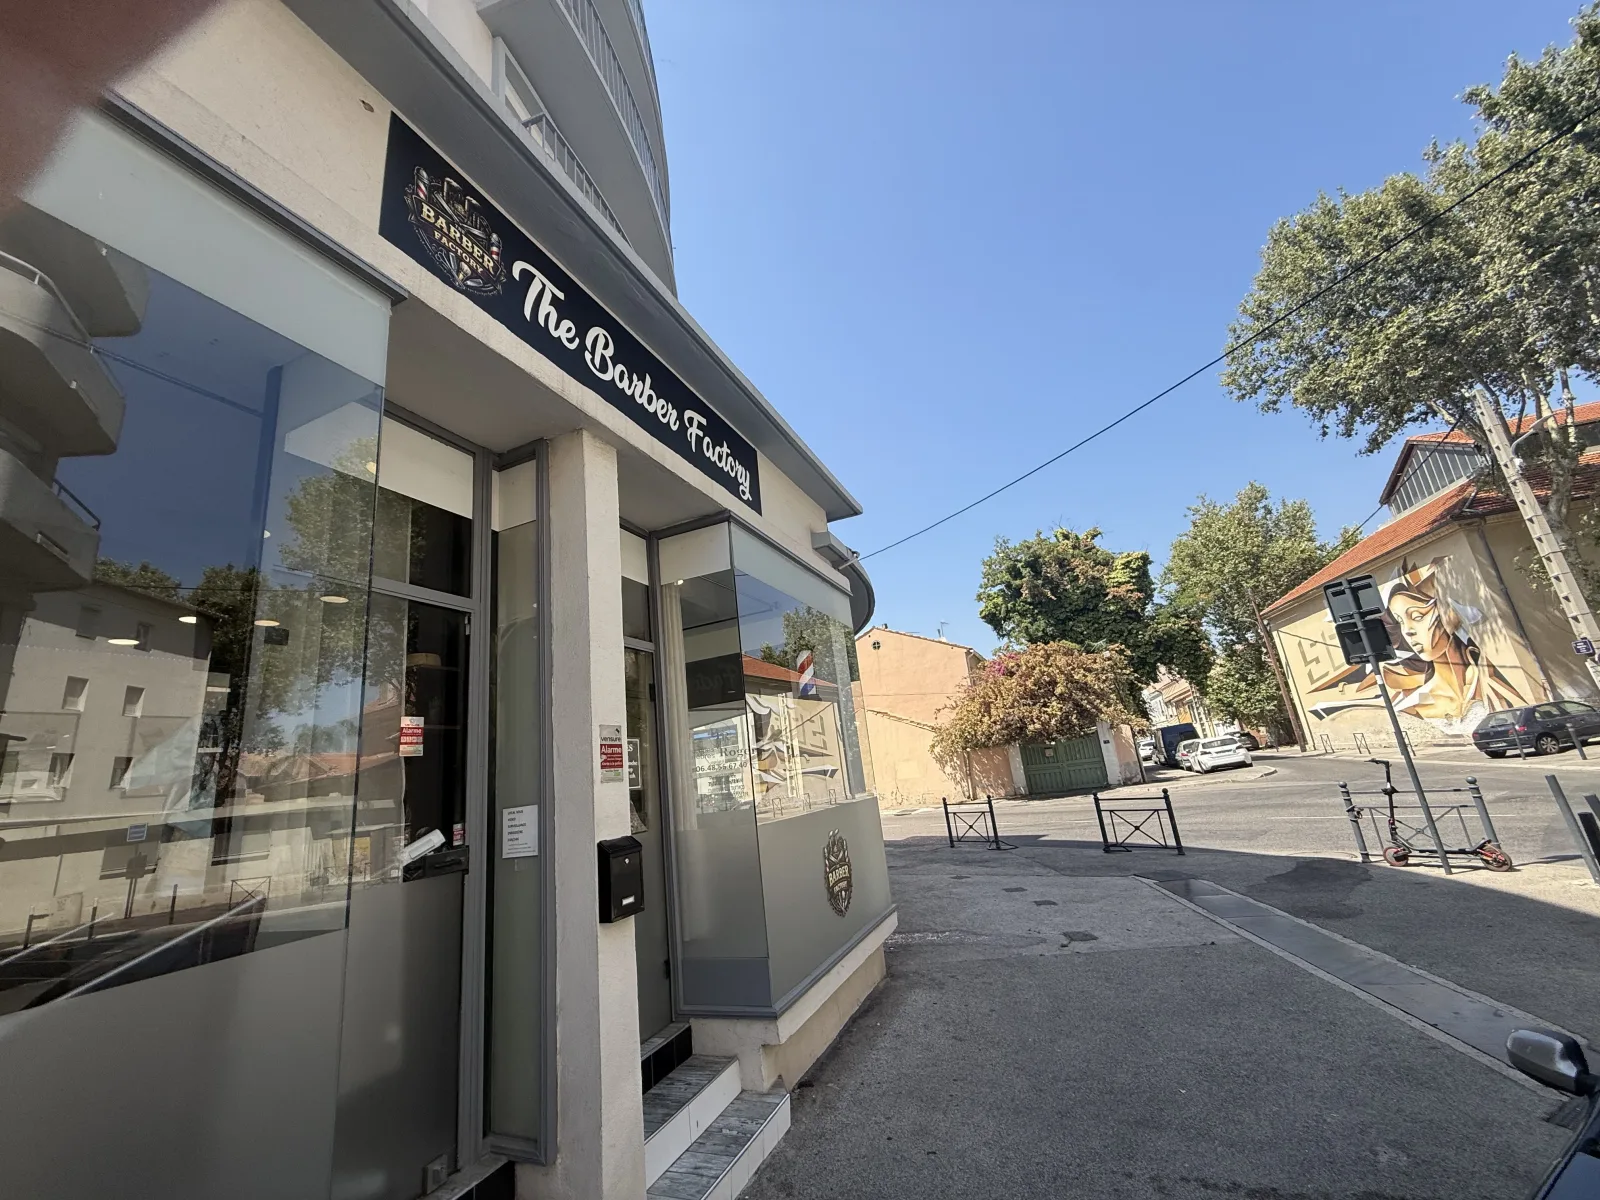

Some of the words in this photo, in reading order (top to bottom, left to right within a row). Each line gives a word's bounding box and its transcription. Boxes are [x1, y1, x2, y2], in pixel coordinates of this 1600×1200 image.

[420, 202, 495, 275] BARBER
[433, 230, 484, 274] FACTORY
[512, 259, 580, 350] The
[584, 325, 680, 431] Barber
[684, 406, 752, 502] Factory
[601, 745, 622, 753] Alarme
[828, 864, 850, 887] BARBER
